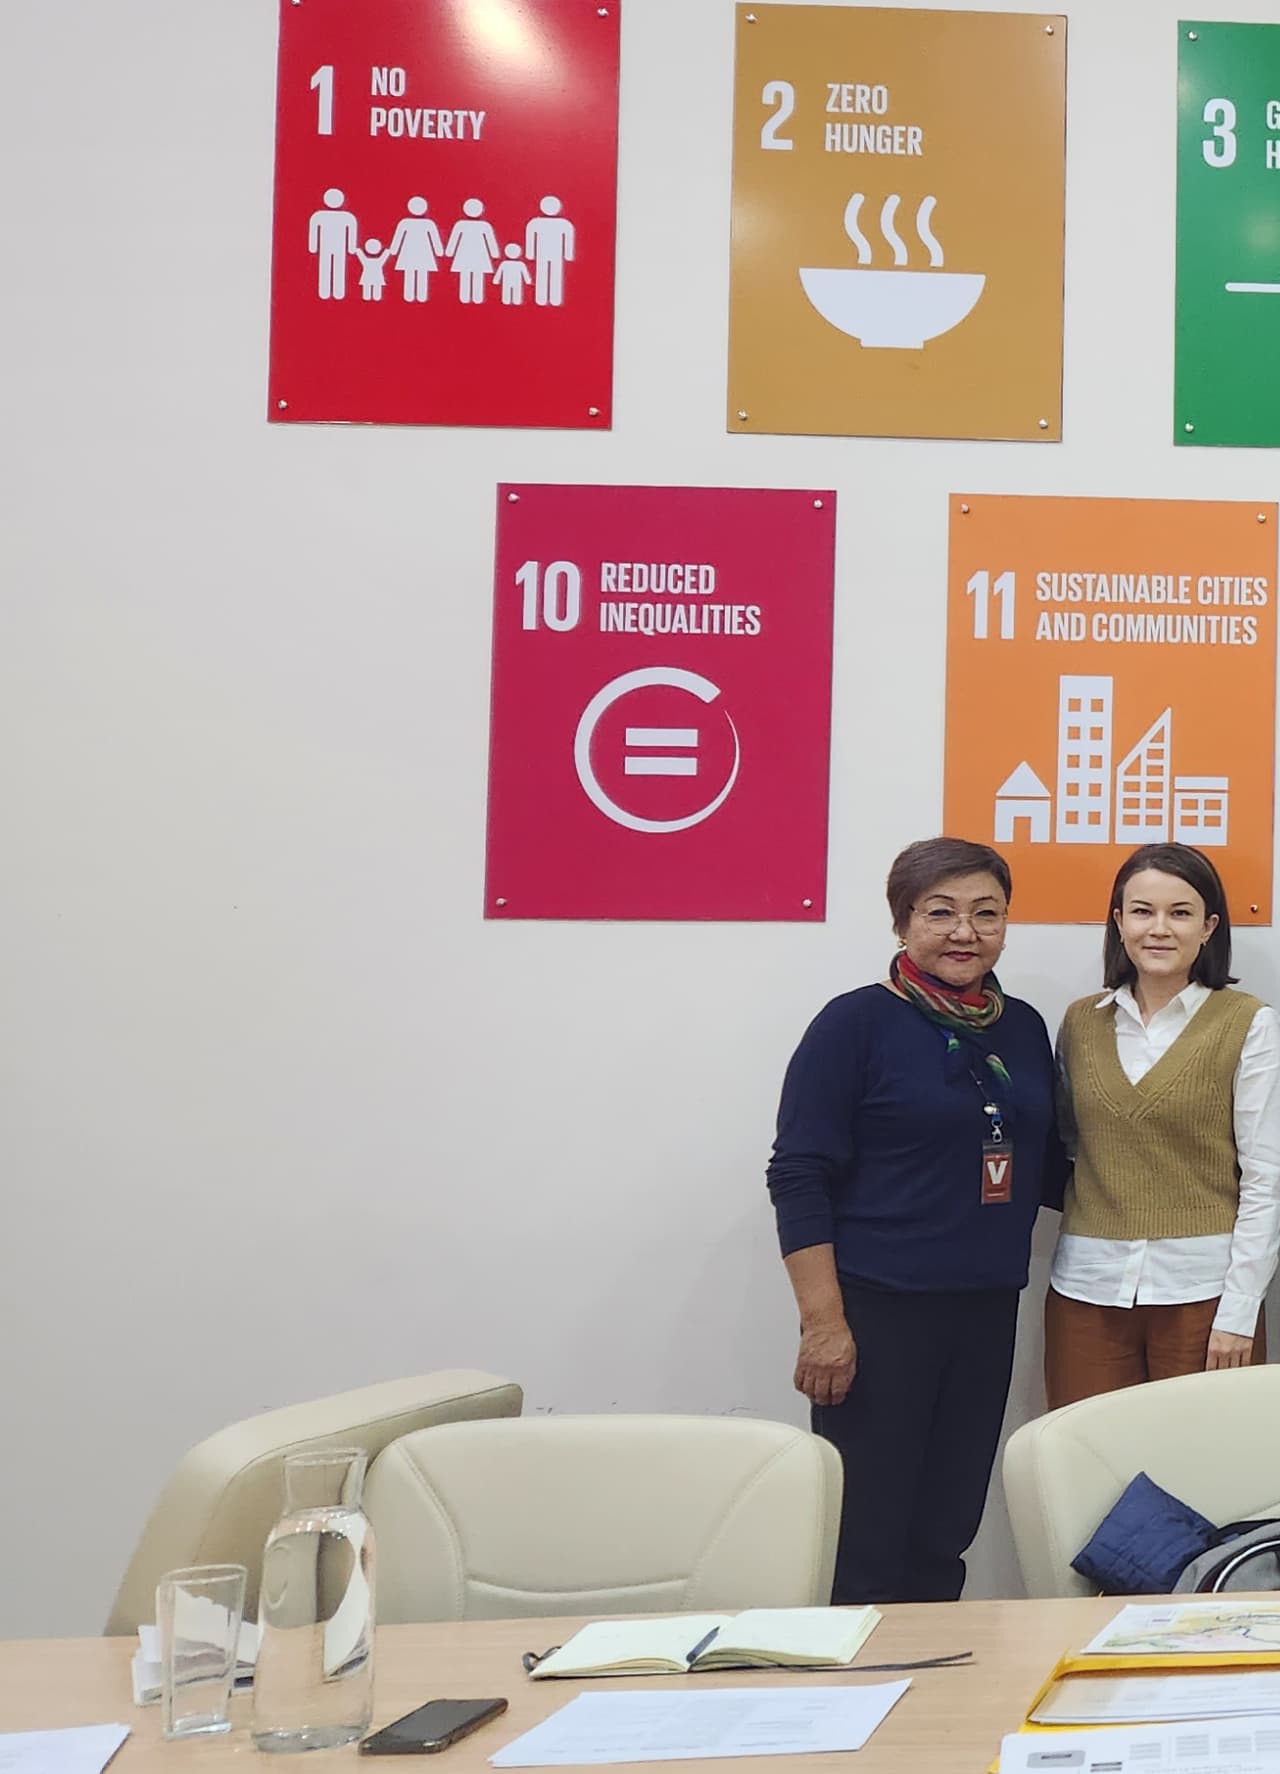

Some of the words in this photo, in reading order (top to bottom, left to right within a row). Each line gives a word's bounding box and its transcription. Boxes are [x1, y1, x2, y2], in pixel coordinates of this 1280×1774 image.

[372, 67, 405, 96] NO
[311, 66, 333, 135] 1
[826, 84, 887, 114] ZERO
[371, 107, 485, 140] POVERTY
[761, 81, 795, 150] 2
[825, 123, 922, 155] HUNGER
[1203, 99, 1236, 167] 3
[601, 563, 715, 594] REDUCED
[1036, 572, 1191, 604] SUSTAINABLE
[1198, 576, 1267, 605] CITIES
[516, 561, 580, 631] 10
[967, 571, 1015, 639] 11
[600, 603, 760, 635] INEQUALITIES
[1036, 612, 1086, 641] AND
[1092, 613, 1257, 644] COMMUNITIES
[986, 1160, 1008, 1185] V
